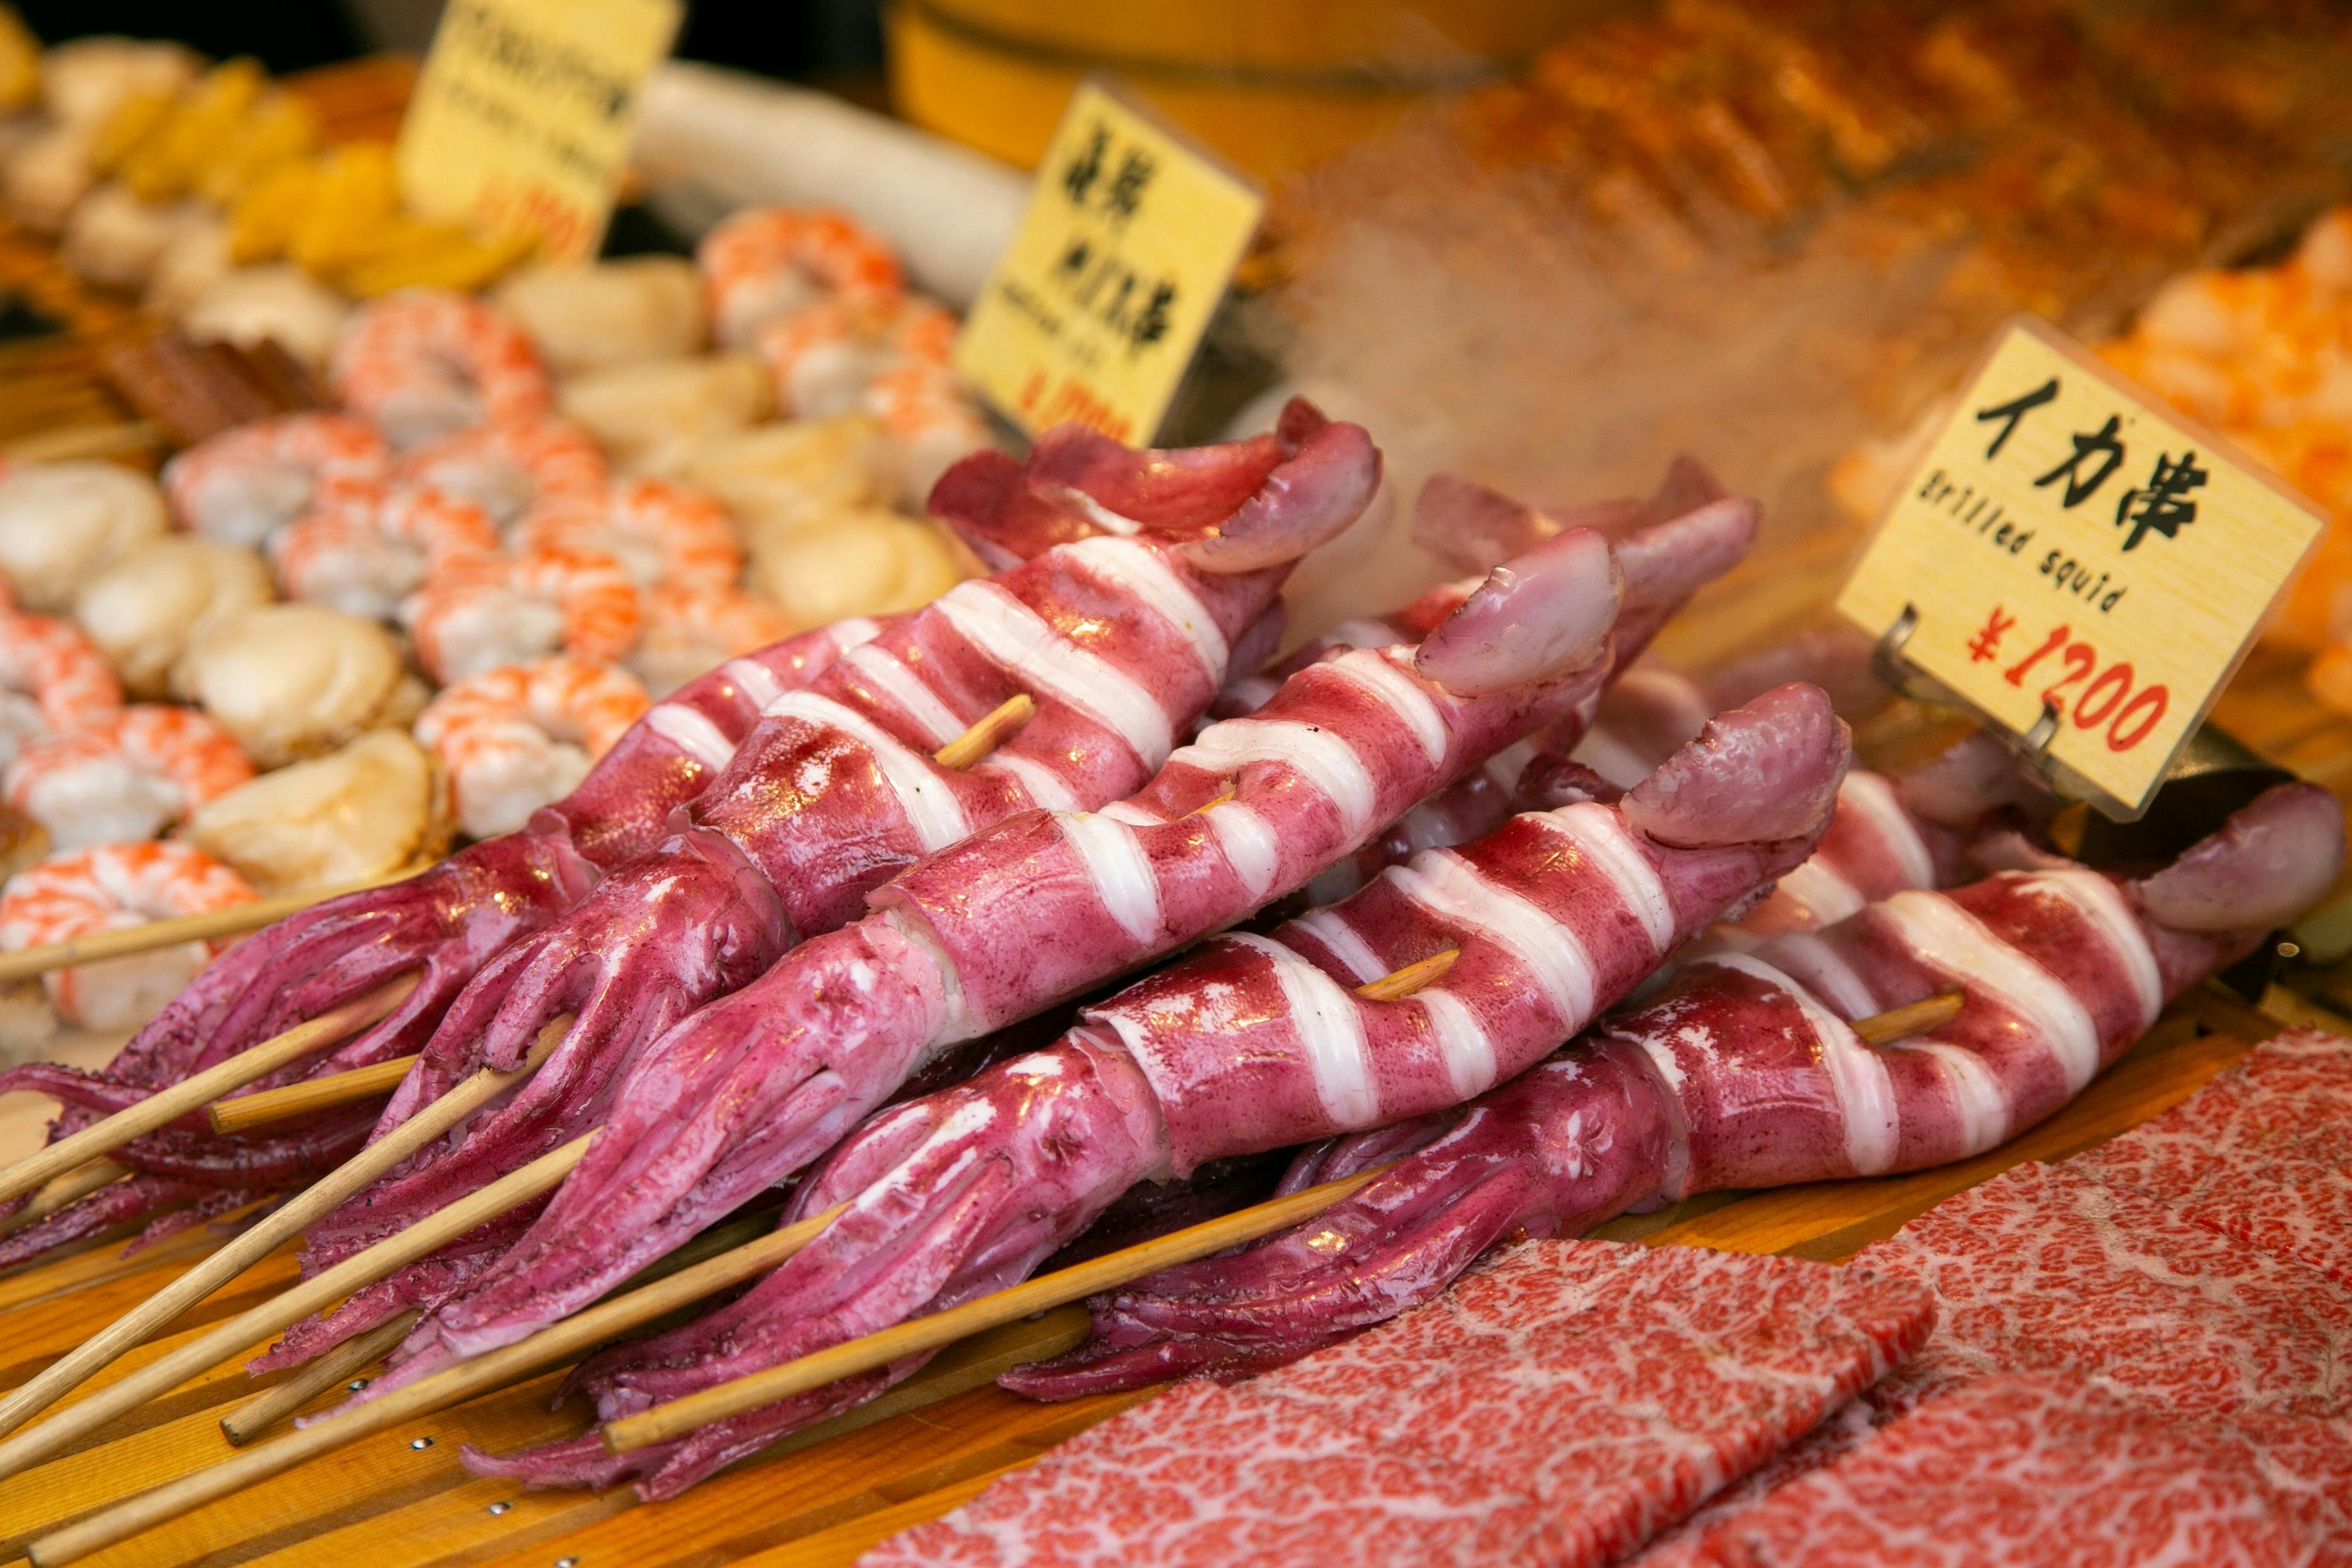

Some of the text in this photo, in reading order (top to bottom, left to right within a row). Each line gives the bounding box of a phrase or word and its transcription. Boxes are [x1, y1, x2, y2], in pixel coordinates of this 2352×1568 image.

[1975, 377, 2209, 552] イカ串
[2039, 548, 2128, 613] squid
